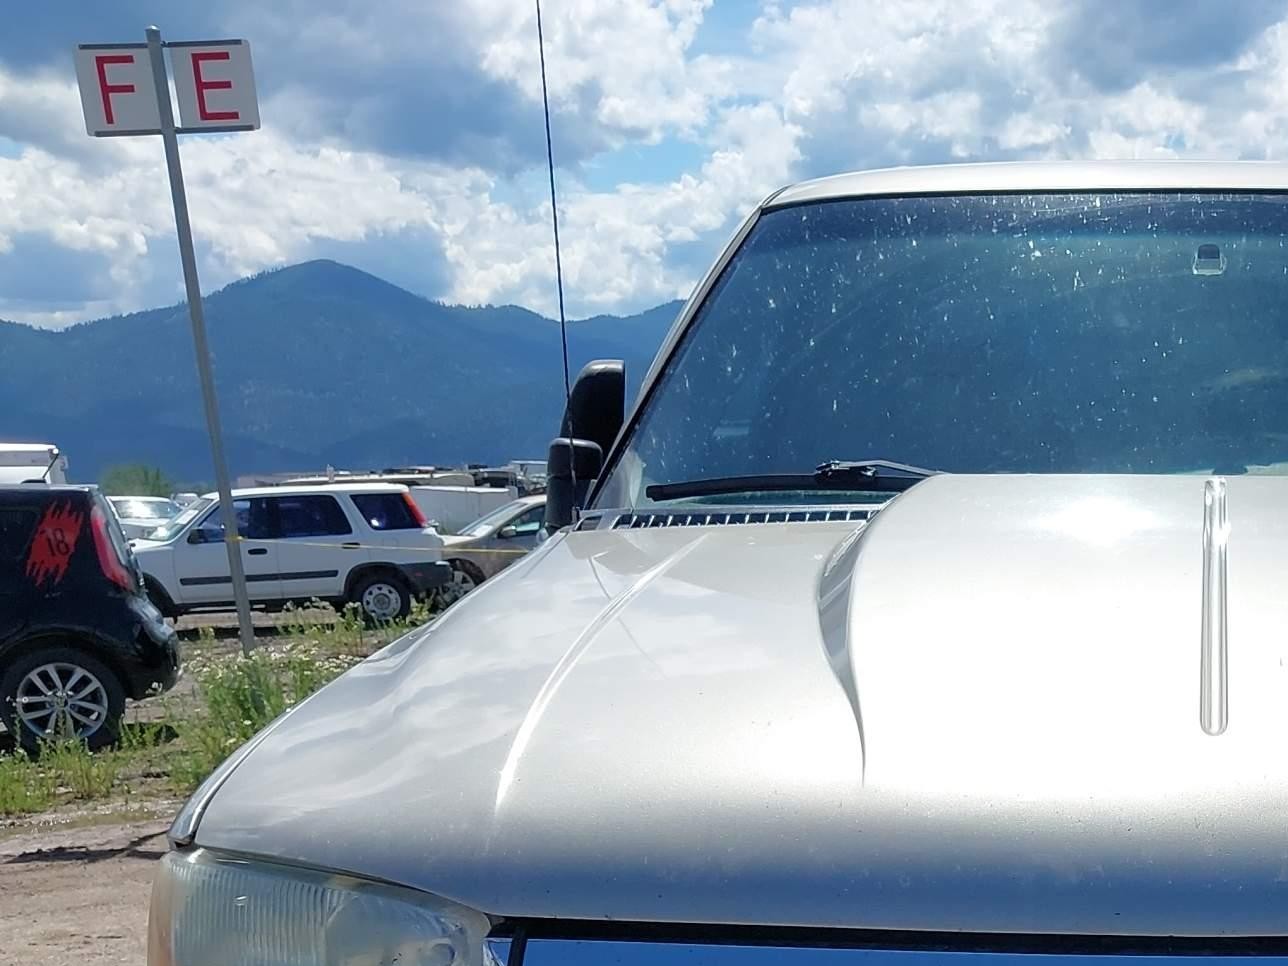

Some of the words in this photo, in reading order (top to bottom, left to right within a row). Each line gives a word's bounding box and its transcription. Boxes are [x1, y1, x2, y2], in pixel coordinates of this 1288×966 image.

[95, 55, 135, 124] F
[191, 52, 239, 121] E
[40, 526, 70, 557] 18
